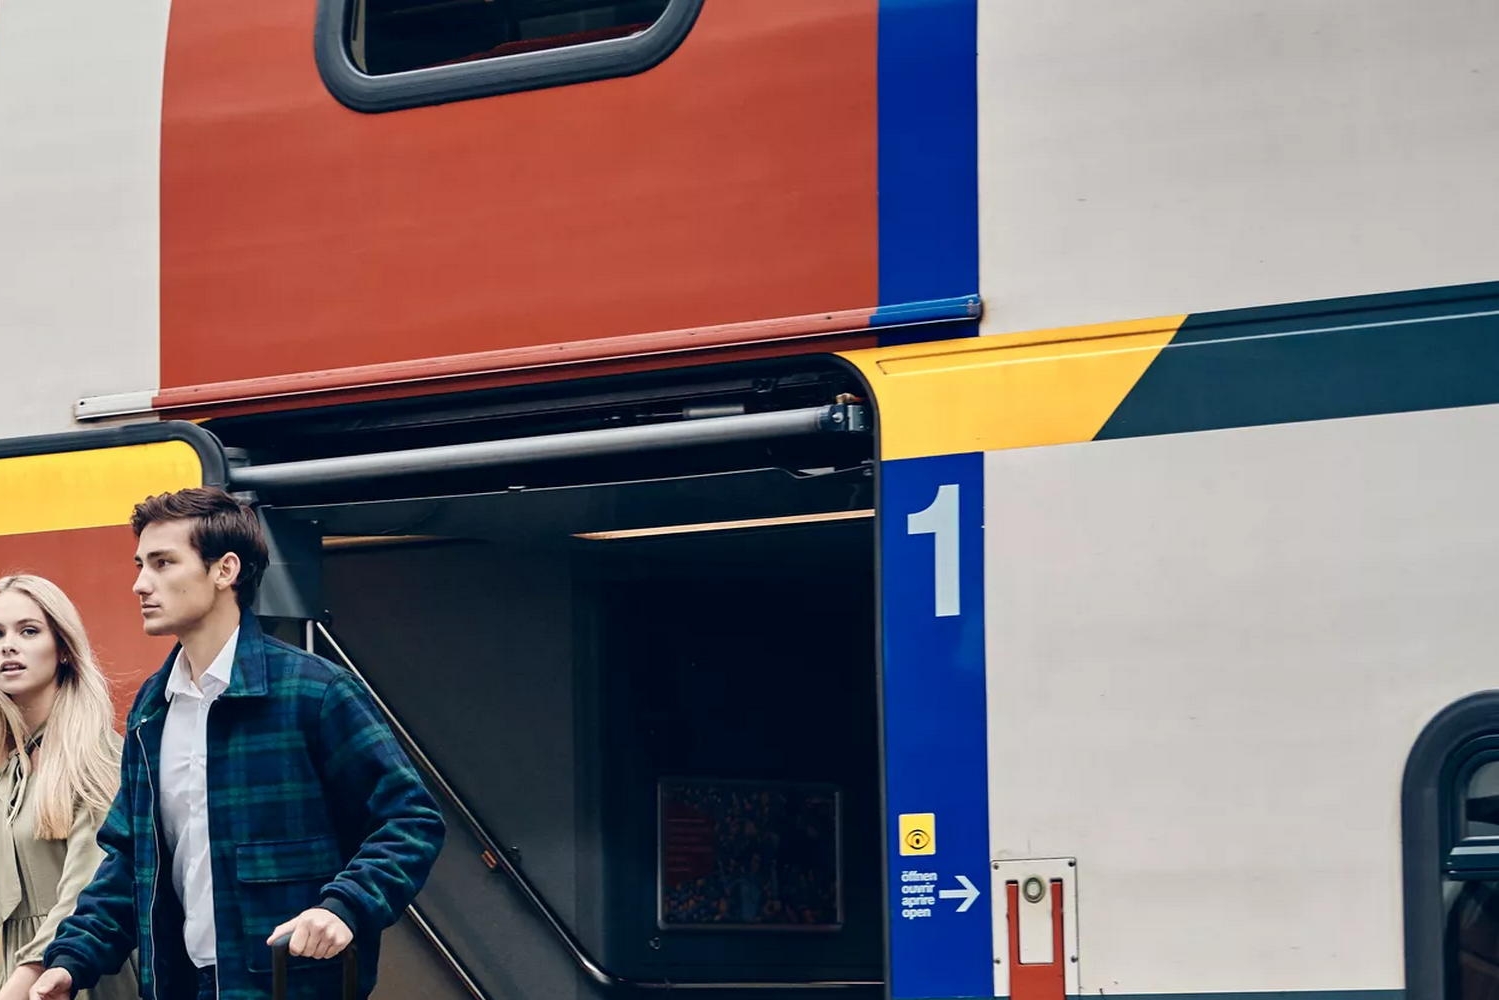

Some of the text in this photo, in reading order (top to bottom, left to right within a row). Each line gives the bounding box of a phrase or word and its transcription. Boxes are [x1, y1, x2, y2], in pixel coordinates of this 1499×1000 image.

[907, 483, 961, 617] 1
[901, 871, 938, 882] öffnen
[901, 882, 935, 894] ouvrir
[901, 894, 935, 908] aprire
[901, 908, 932, 920] open
